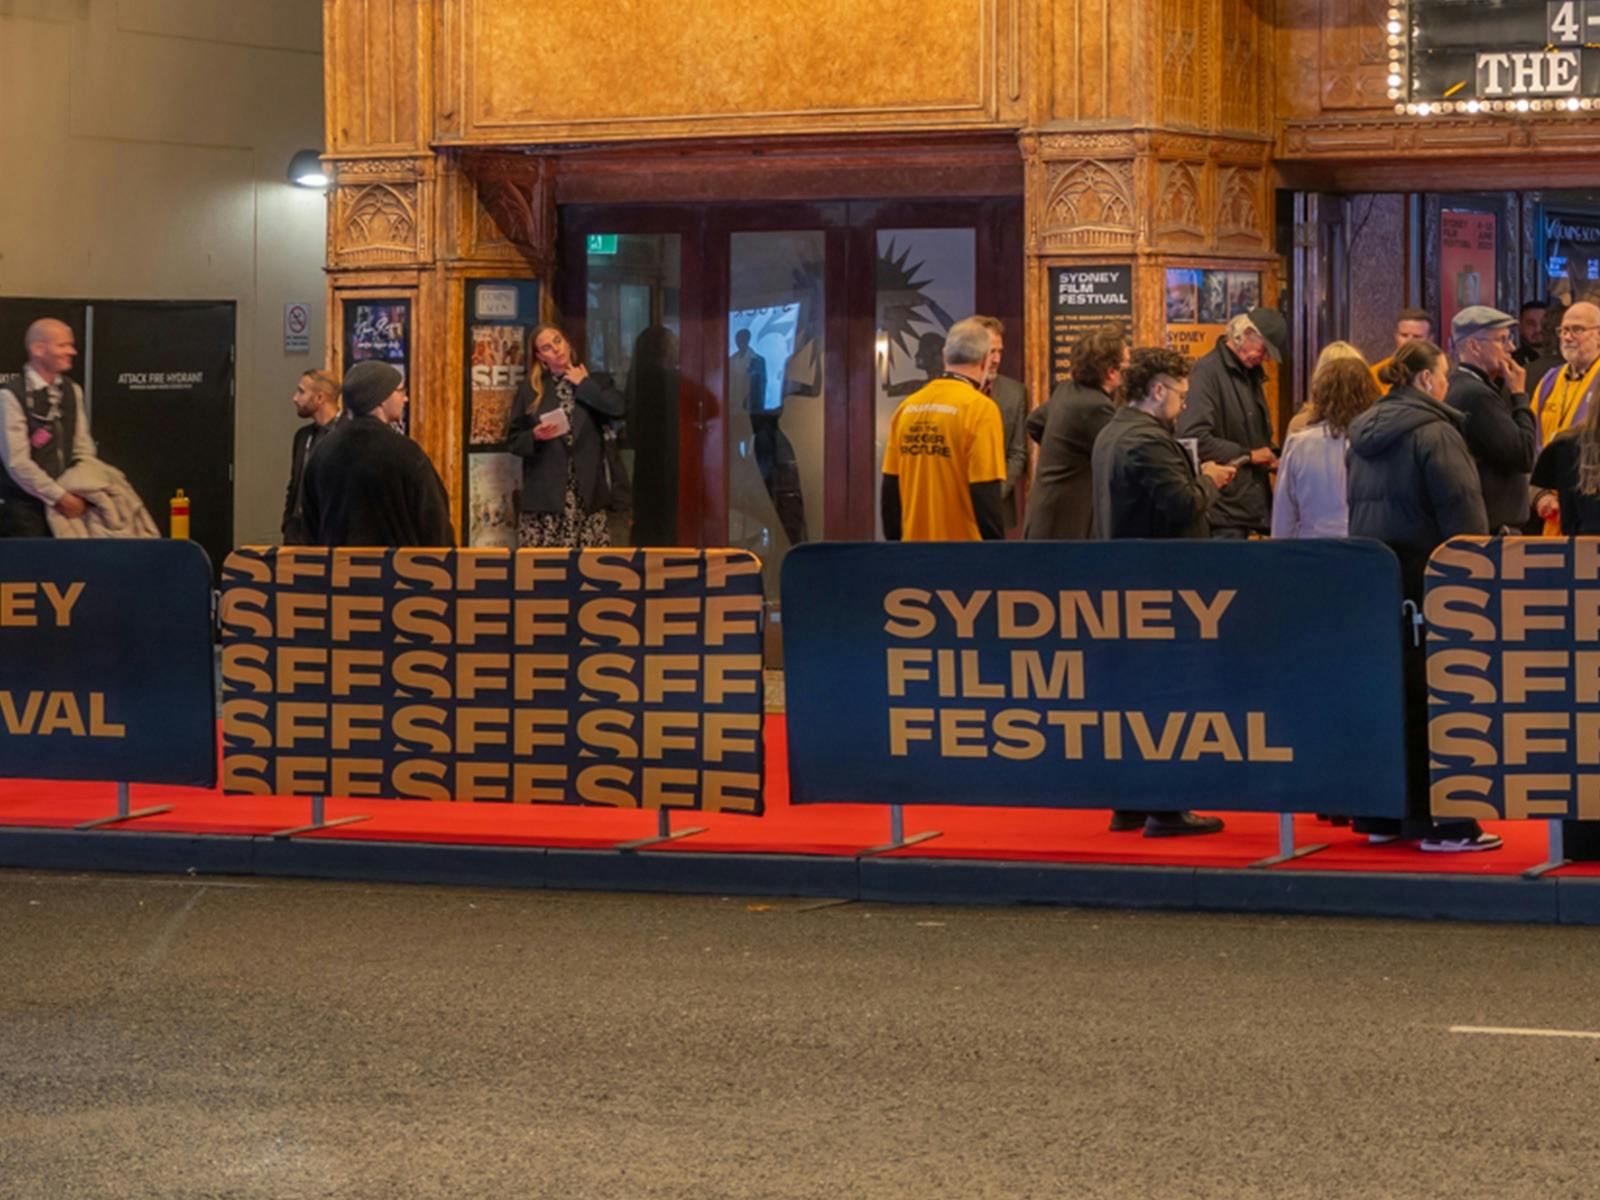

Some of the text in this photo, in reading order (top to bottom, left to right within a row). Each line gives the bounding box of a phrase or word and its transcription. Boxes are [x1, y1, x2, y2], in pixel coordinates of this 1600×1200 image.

[1478, 52, 1579, 95] THE
[1059, 272, 1120, 283] SYDNEY
[1059, 283, 1094, 293] FILM
[1059, 293, 1128, 305] FESTIVAL
[118, 372, 203, 384] ATTACK FIRE HYDRANT
[884, 589, 1236, 639] SYDNEY
[888, 649, 1084, 699] FILM
[889, 708, 1293, 761] FESTIVAL
